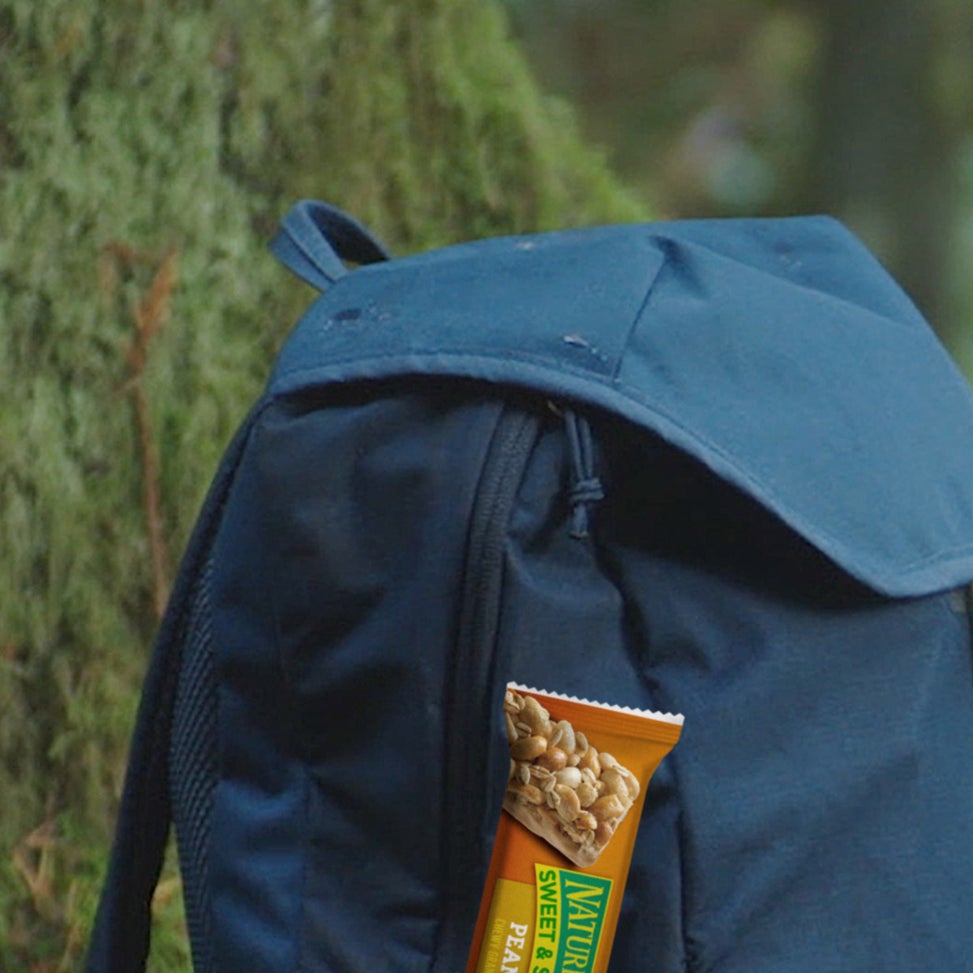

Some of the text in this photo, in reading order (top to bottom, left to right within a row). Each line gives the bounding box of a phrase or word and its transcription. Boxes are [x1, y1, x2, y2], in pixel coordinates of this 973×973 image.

[538, 870, 558, 943] SWEET
[491, 918, 507, 948] CHEWY
[536, 946, 553, 960] &
